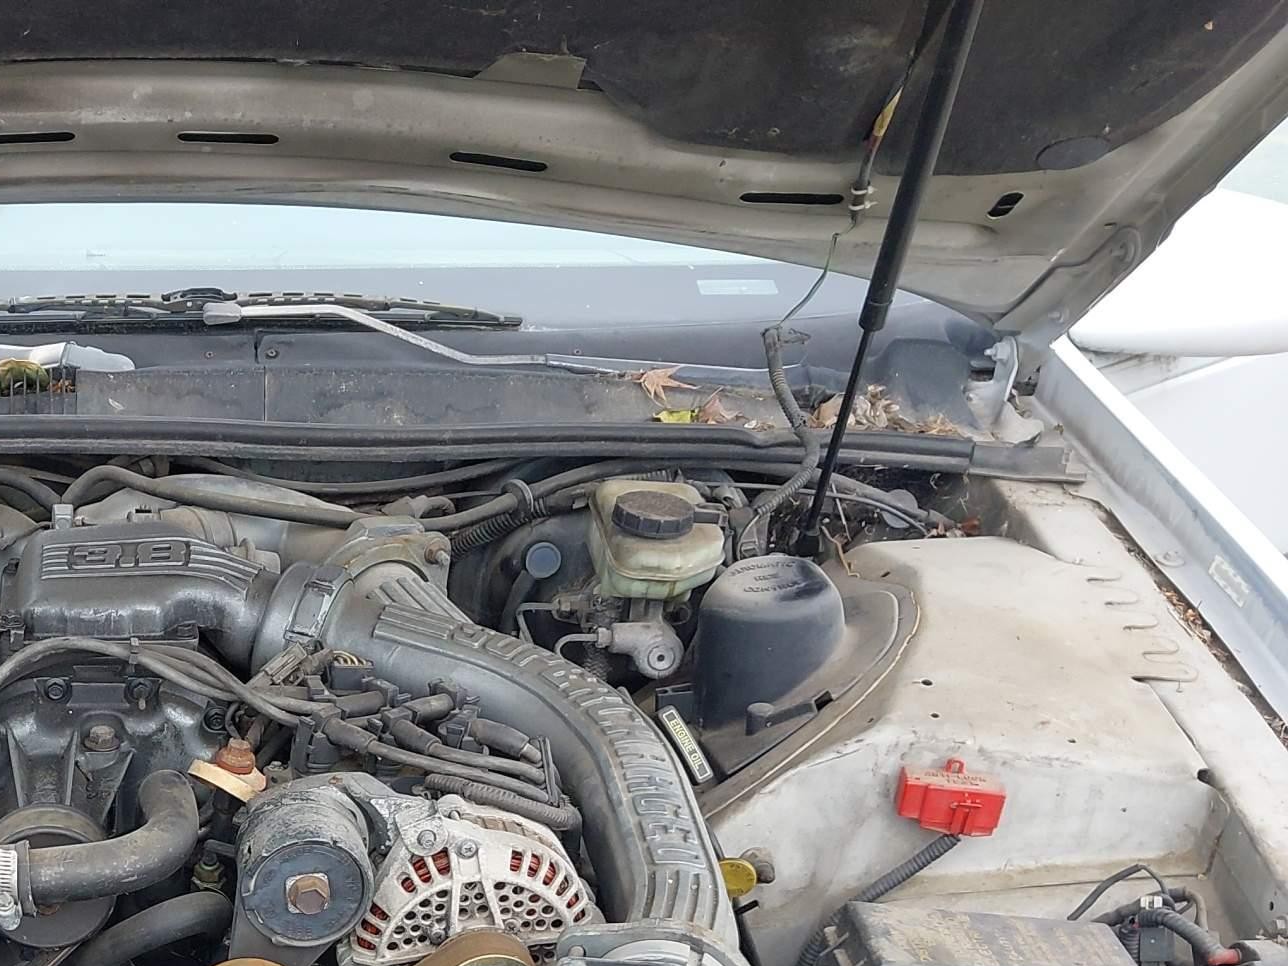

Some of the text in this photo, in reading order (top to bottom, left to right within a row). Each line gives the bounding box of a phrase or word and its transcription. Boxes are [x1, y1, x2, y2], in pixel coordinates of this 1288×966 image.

[67, 542, 188, 568] 3.8
[670, 718, 705, 771] ENGINE OIL
